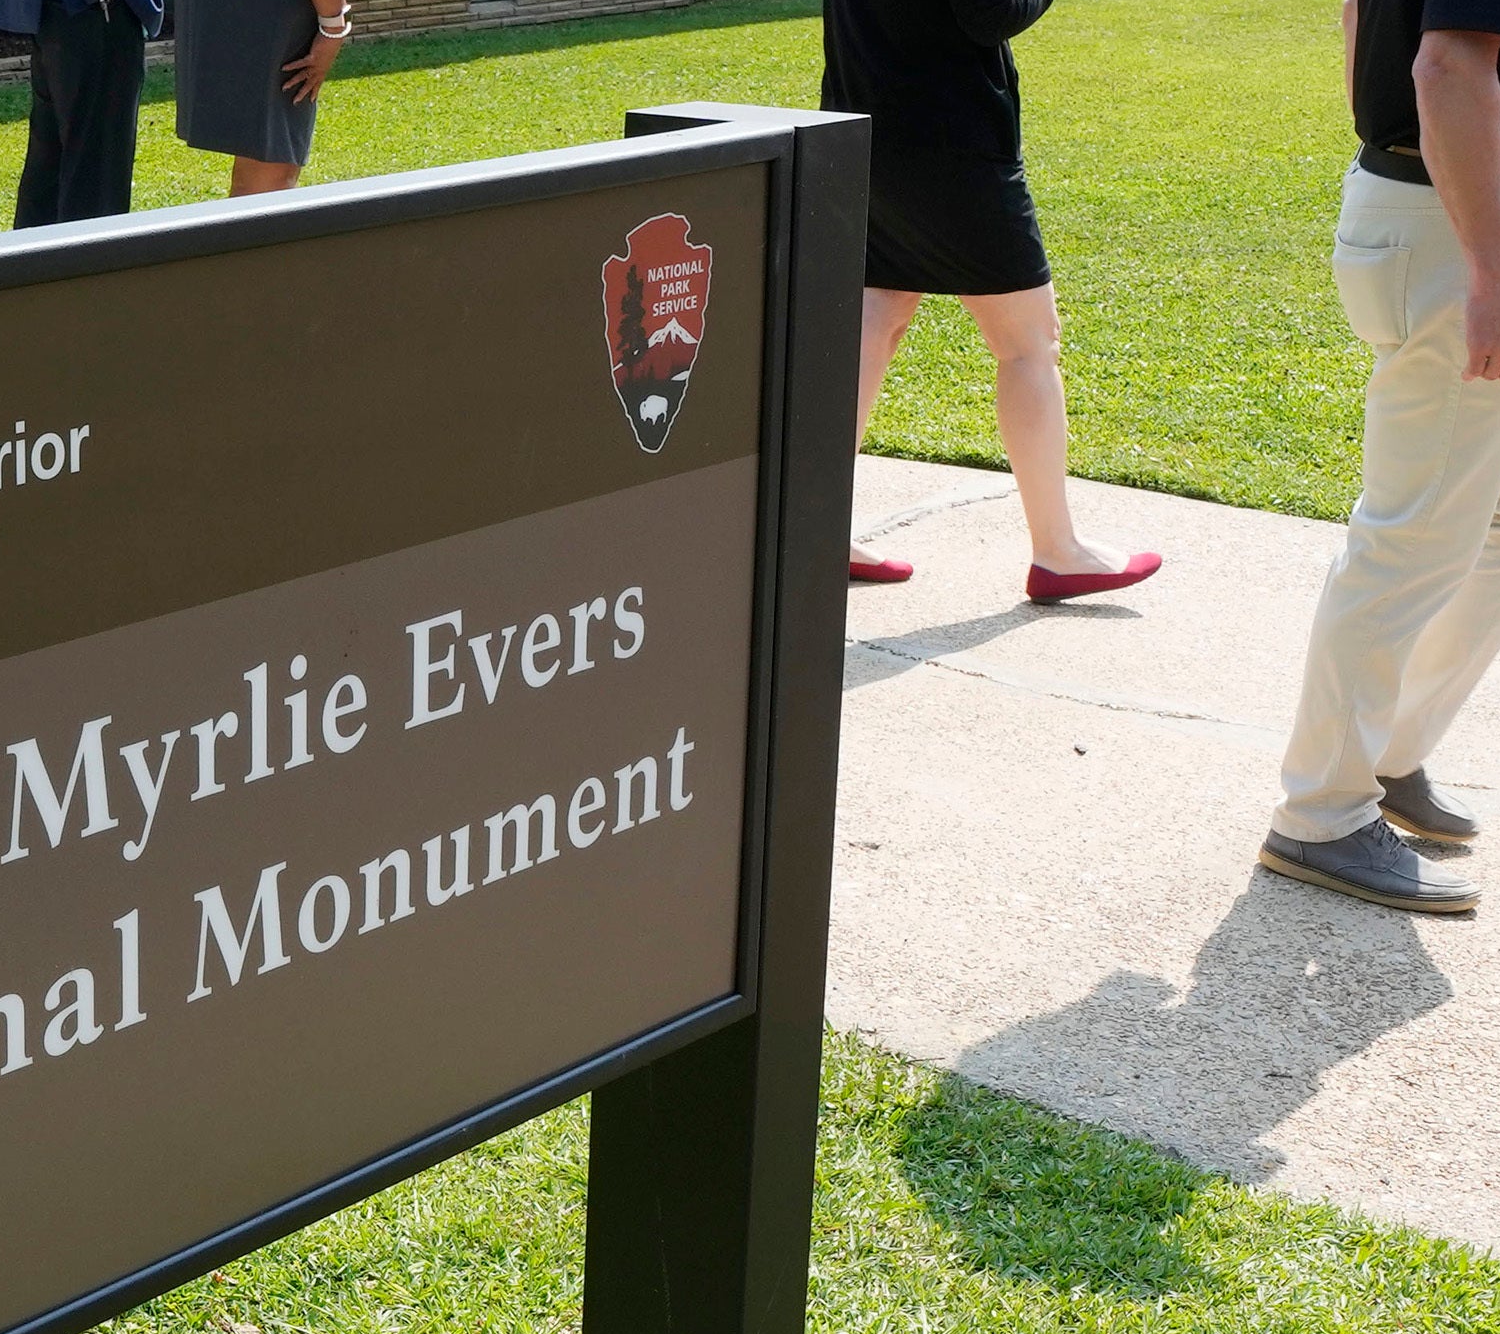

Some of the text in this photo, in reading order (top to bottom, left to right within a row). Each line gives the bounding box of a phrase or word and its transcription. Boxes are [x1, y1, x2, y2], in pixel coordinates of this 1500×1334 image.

[647, 259, 705, 283] NATIONAL
[661, 279, 691, 298] PARK
[652, 295, 698, 317] SERVICE
[0, 653, 369, 866] Myrlie
[403, 585, 646, 731] Evers
[186, 725, 696, 1005] Monument
